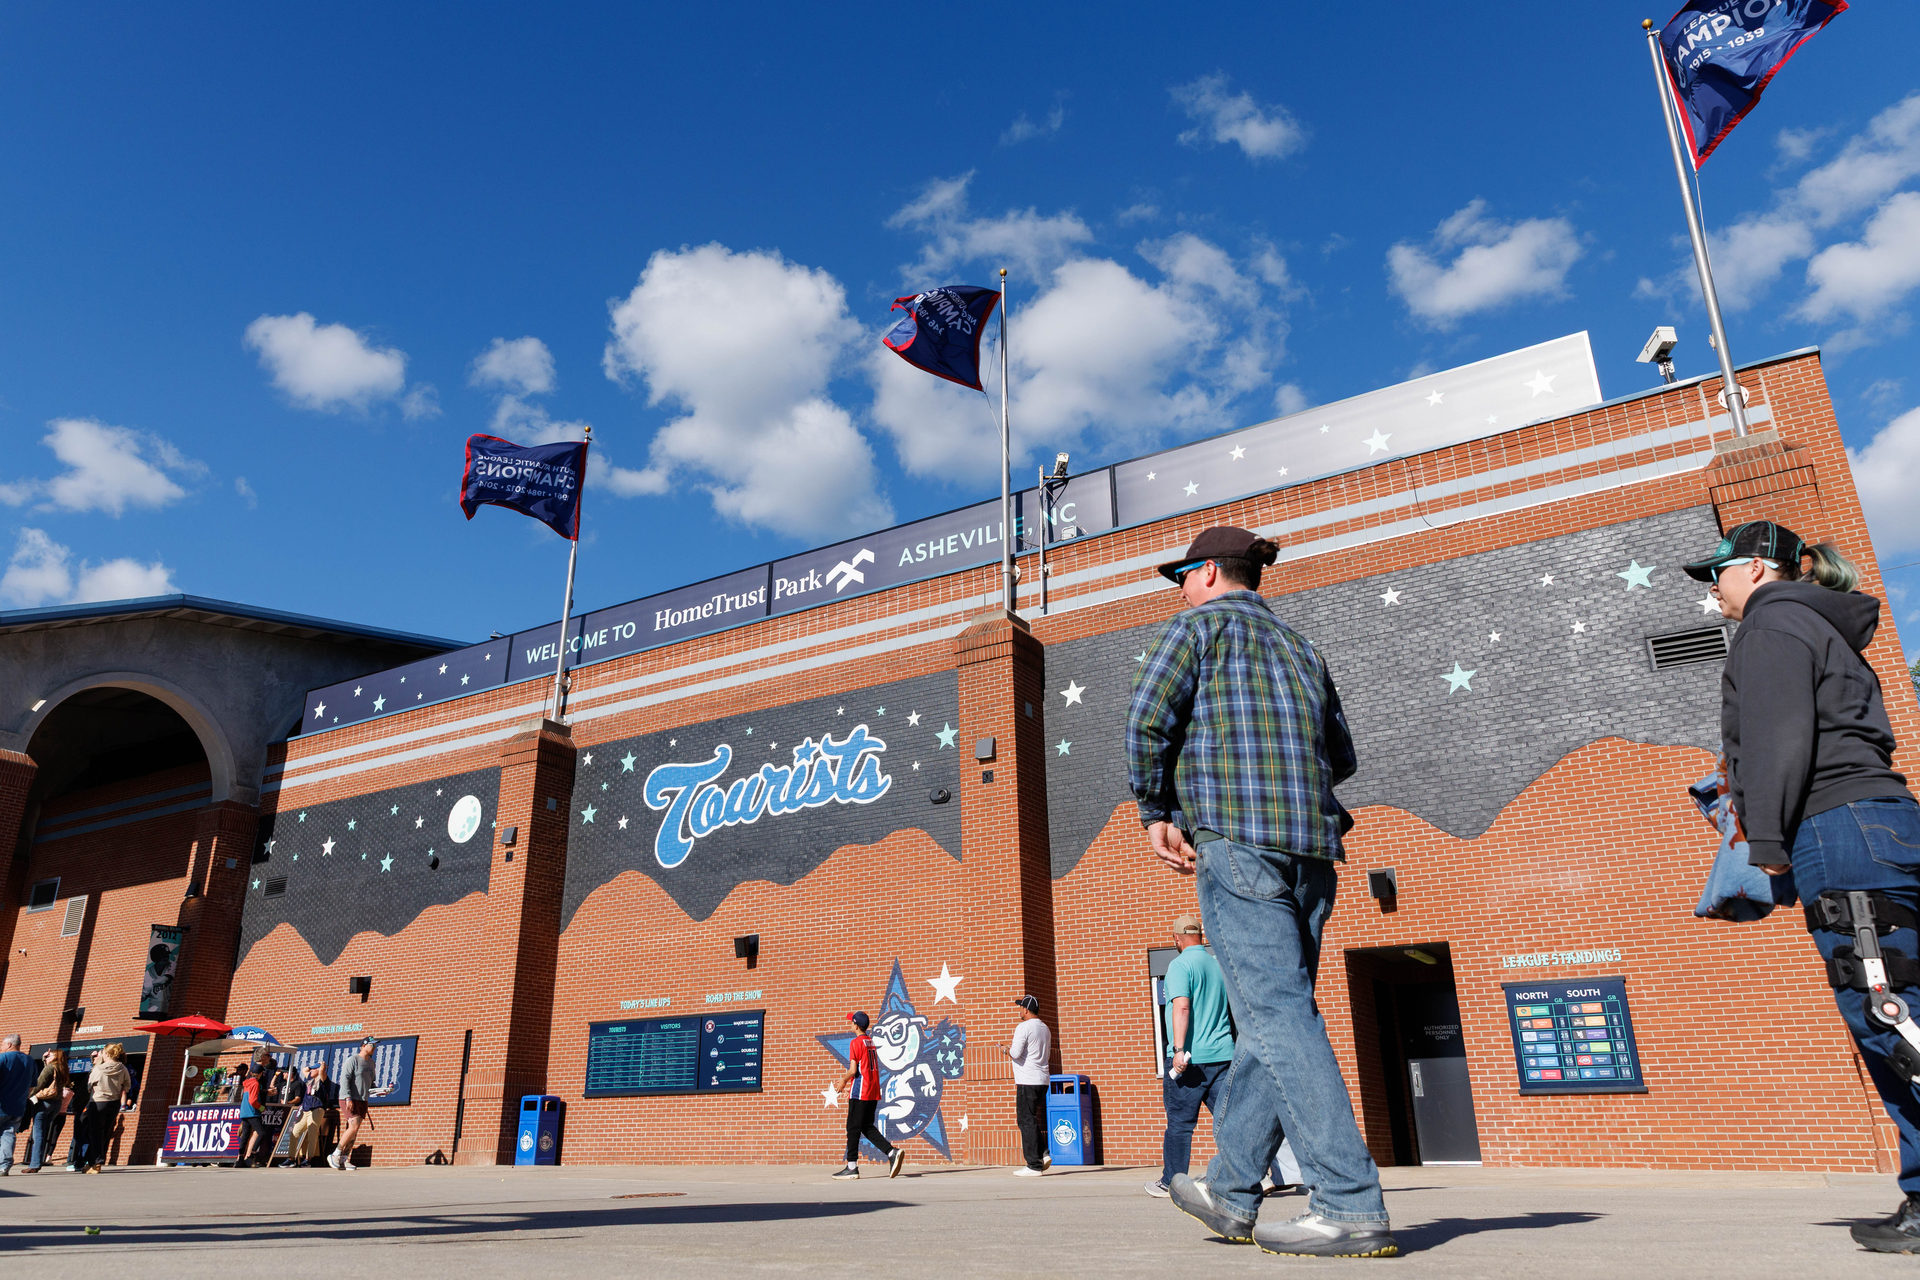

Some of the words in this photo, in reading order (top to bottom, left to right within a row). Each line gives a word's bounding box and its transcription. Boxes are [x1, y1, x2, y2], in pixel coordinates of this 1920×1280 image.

[1683, 0, 1740, 35] LEAGUE
[1689, 48, 1711, 71] 1915
[1727, 27, 1765, 48] 1939
[1043, 503, 1077, 528] NC
[654, 585, 767, 631] HomeTrust
[774, 569, 822, 600] Park
[612, 621, 636, 641] TO
[643, 723, 892, 869] Tourists
[1502, 953, 1549, 968] LEAGUE
[1551, 949, 1622, 965] STANDINGS
[705, 994, 724, 1003] ROAD
[724, 993, 732, 1002] TO
[733, 992, 744, 1001] THE
[745, 990, 763, 1000] SHOW
[1515, 991, 1549, 1000] NORTH
[1566, 988, 1601, 998] SOUTH
[620, 1001, 645, 1010] TODAY'S
[645, 999, 658, 1008] LINE
[659, 997, 671, 1007] UPS
[171, 1110, 195, 1121] COLD
[196, 1109, 219, 1120] BEER
[220, 1108, 240, 1120] HER
[174, 1120, 232, 1152] DALE'S
